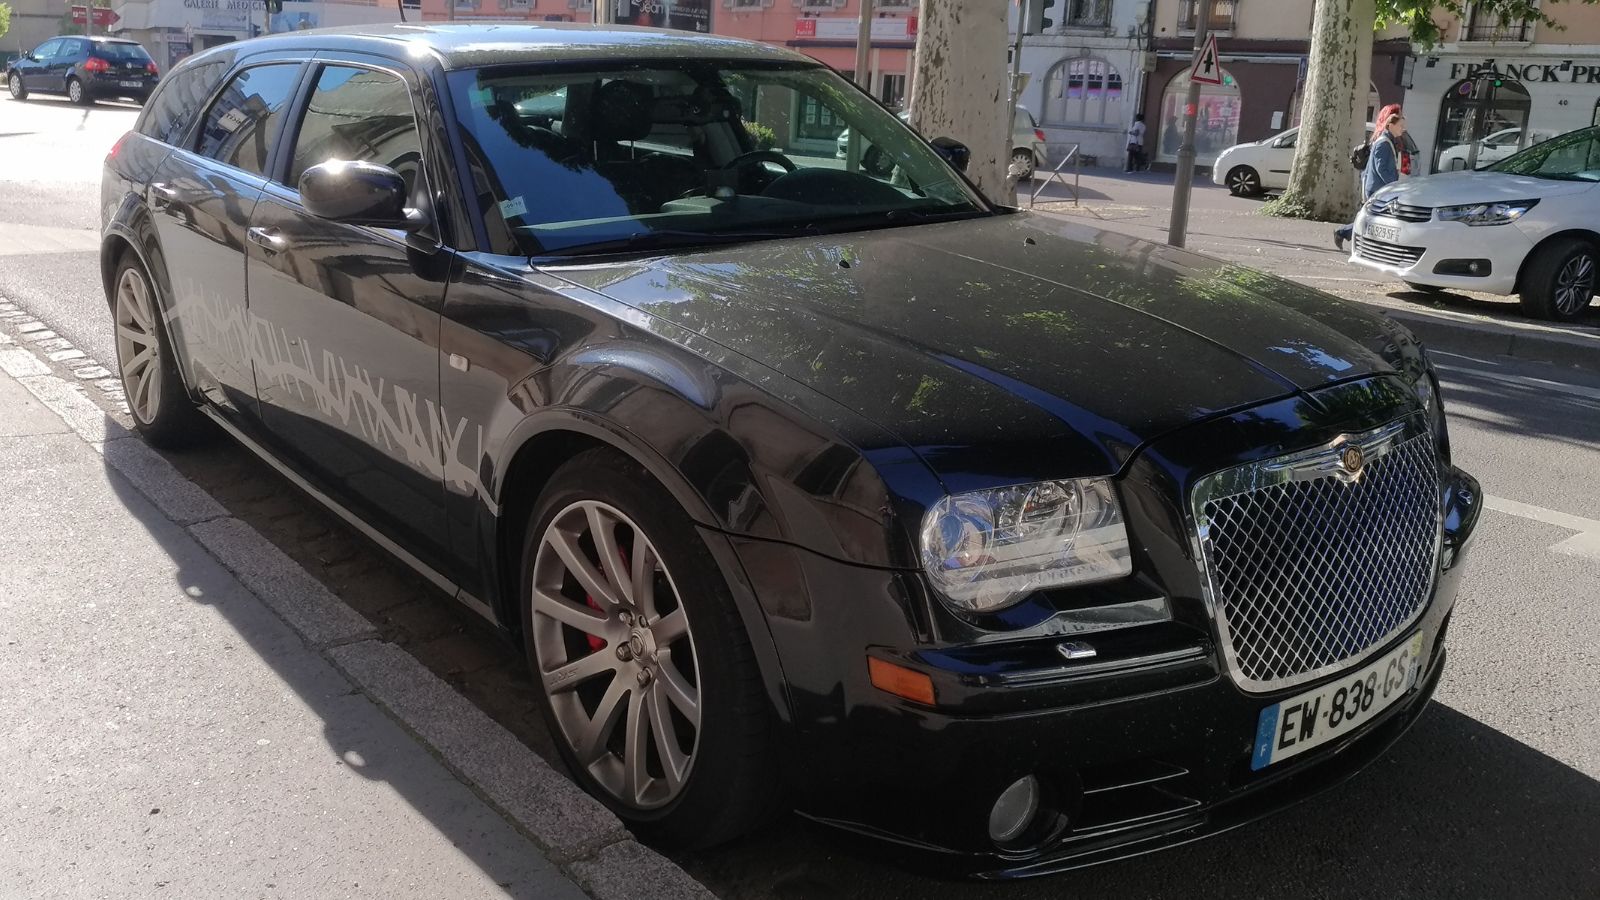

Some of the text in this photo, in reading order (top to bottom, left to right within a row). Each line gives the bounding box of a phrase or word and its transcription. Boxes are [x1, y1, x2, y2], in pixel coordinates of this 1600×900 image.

[1450, 62, 1561, 82] FRANCK
[1278, 649, 1409, 750] EW-838-GS
[1260, 743, 1268, 757] F
